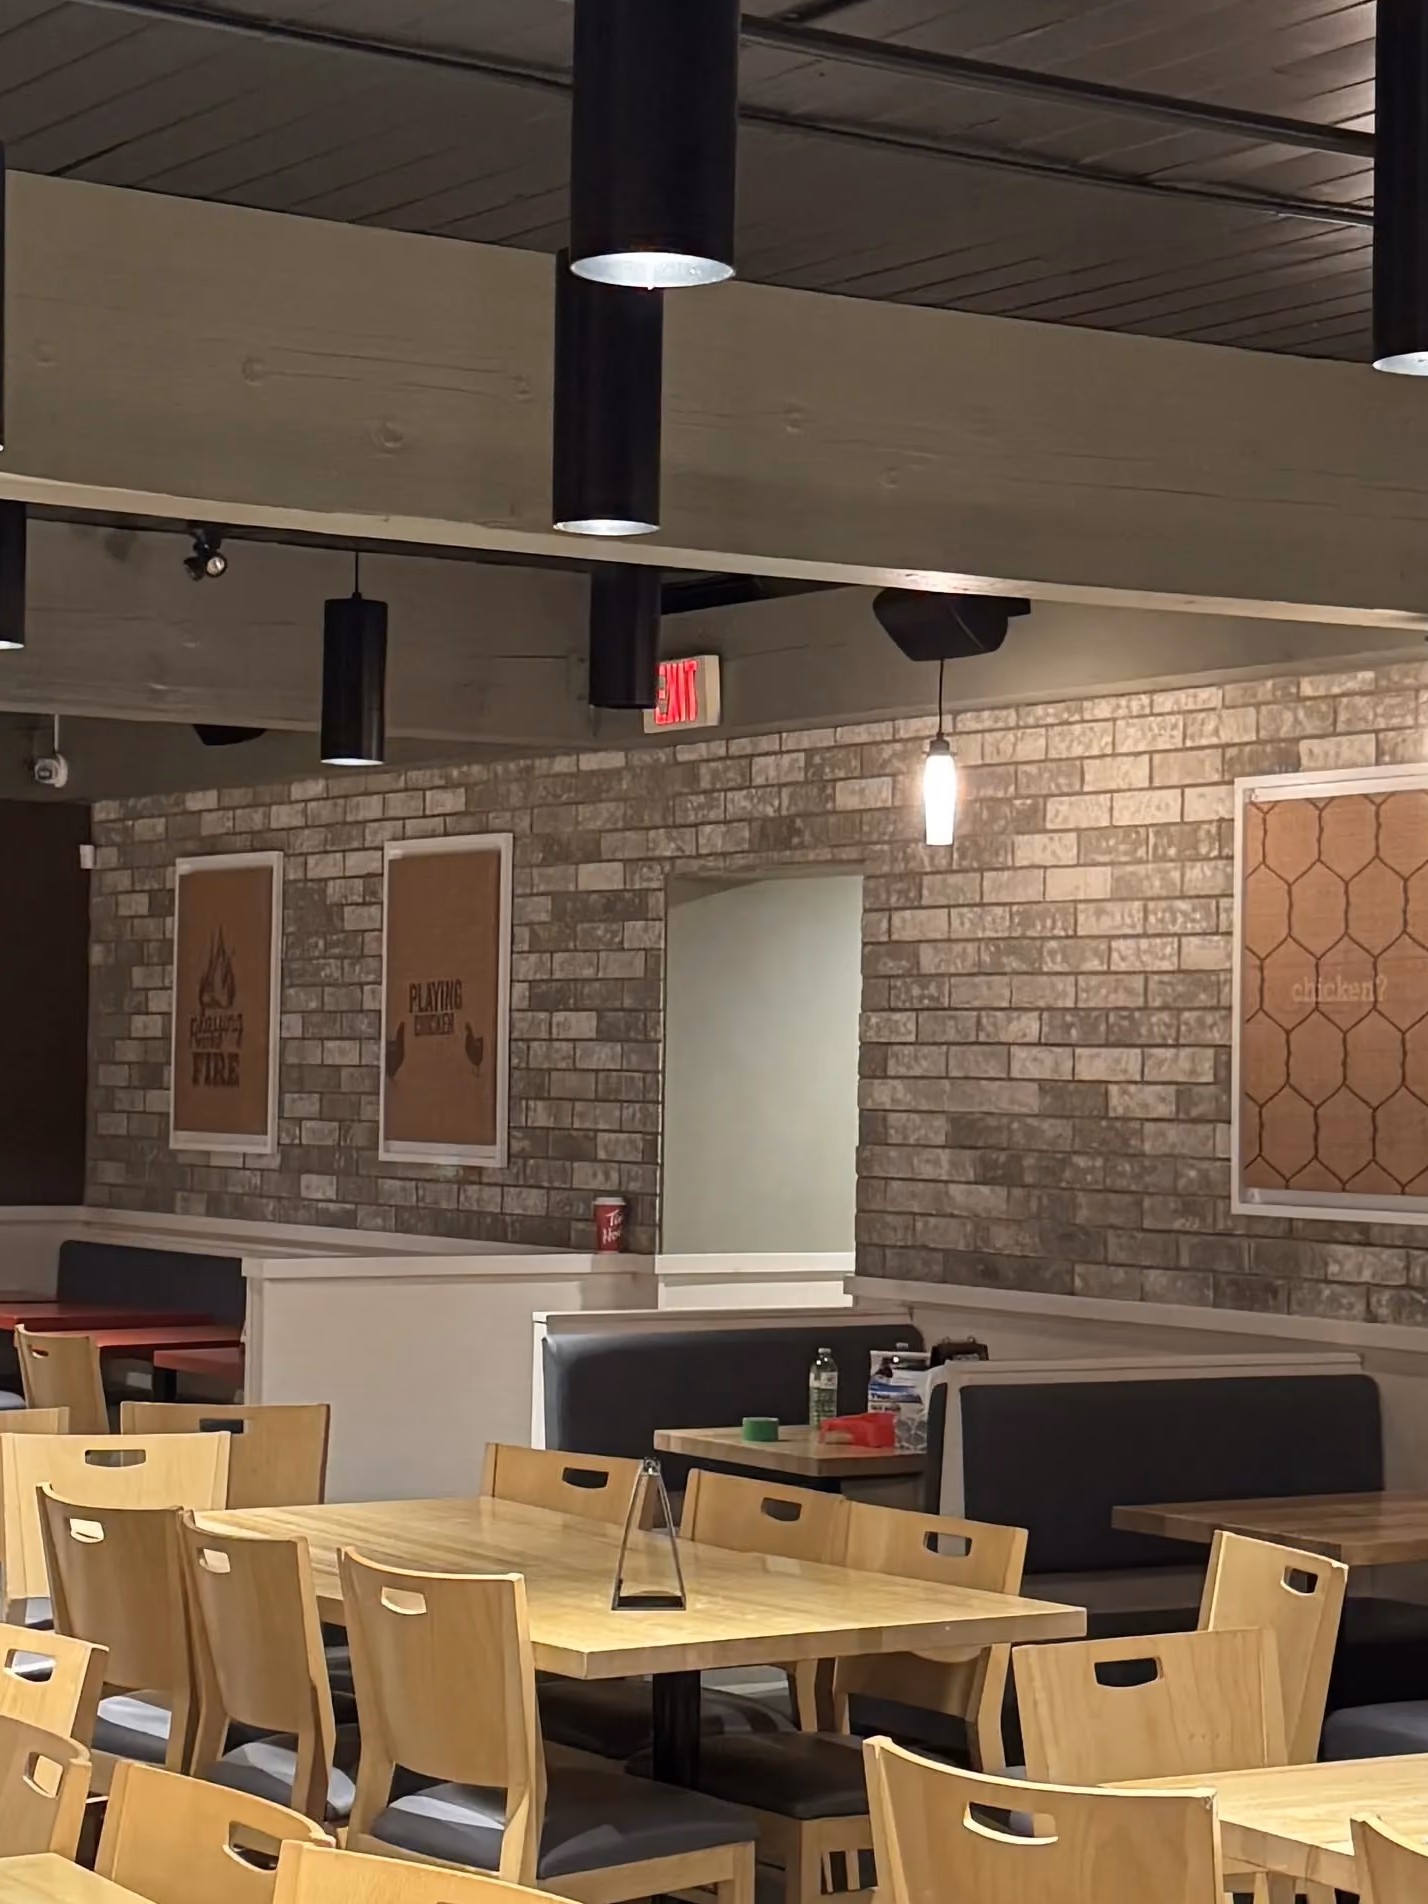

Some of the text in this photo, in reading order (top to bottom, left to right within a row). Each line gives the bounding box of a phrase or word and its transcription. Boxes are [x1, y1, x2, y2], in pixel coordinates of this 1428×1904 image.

[655, 660, 697, 724] EXIT
[409, 979, 462, 1014] PLAYING
[1292, 974, 1388, 1001] chicken?
[192, 1052, 240, 1088] FIRE
